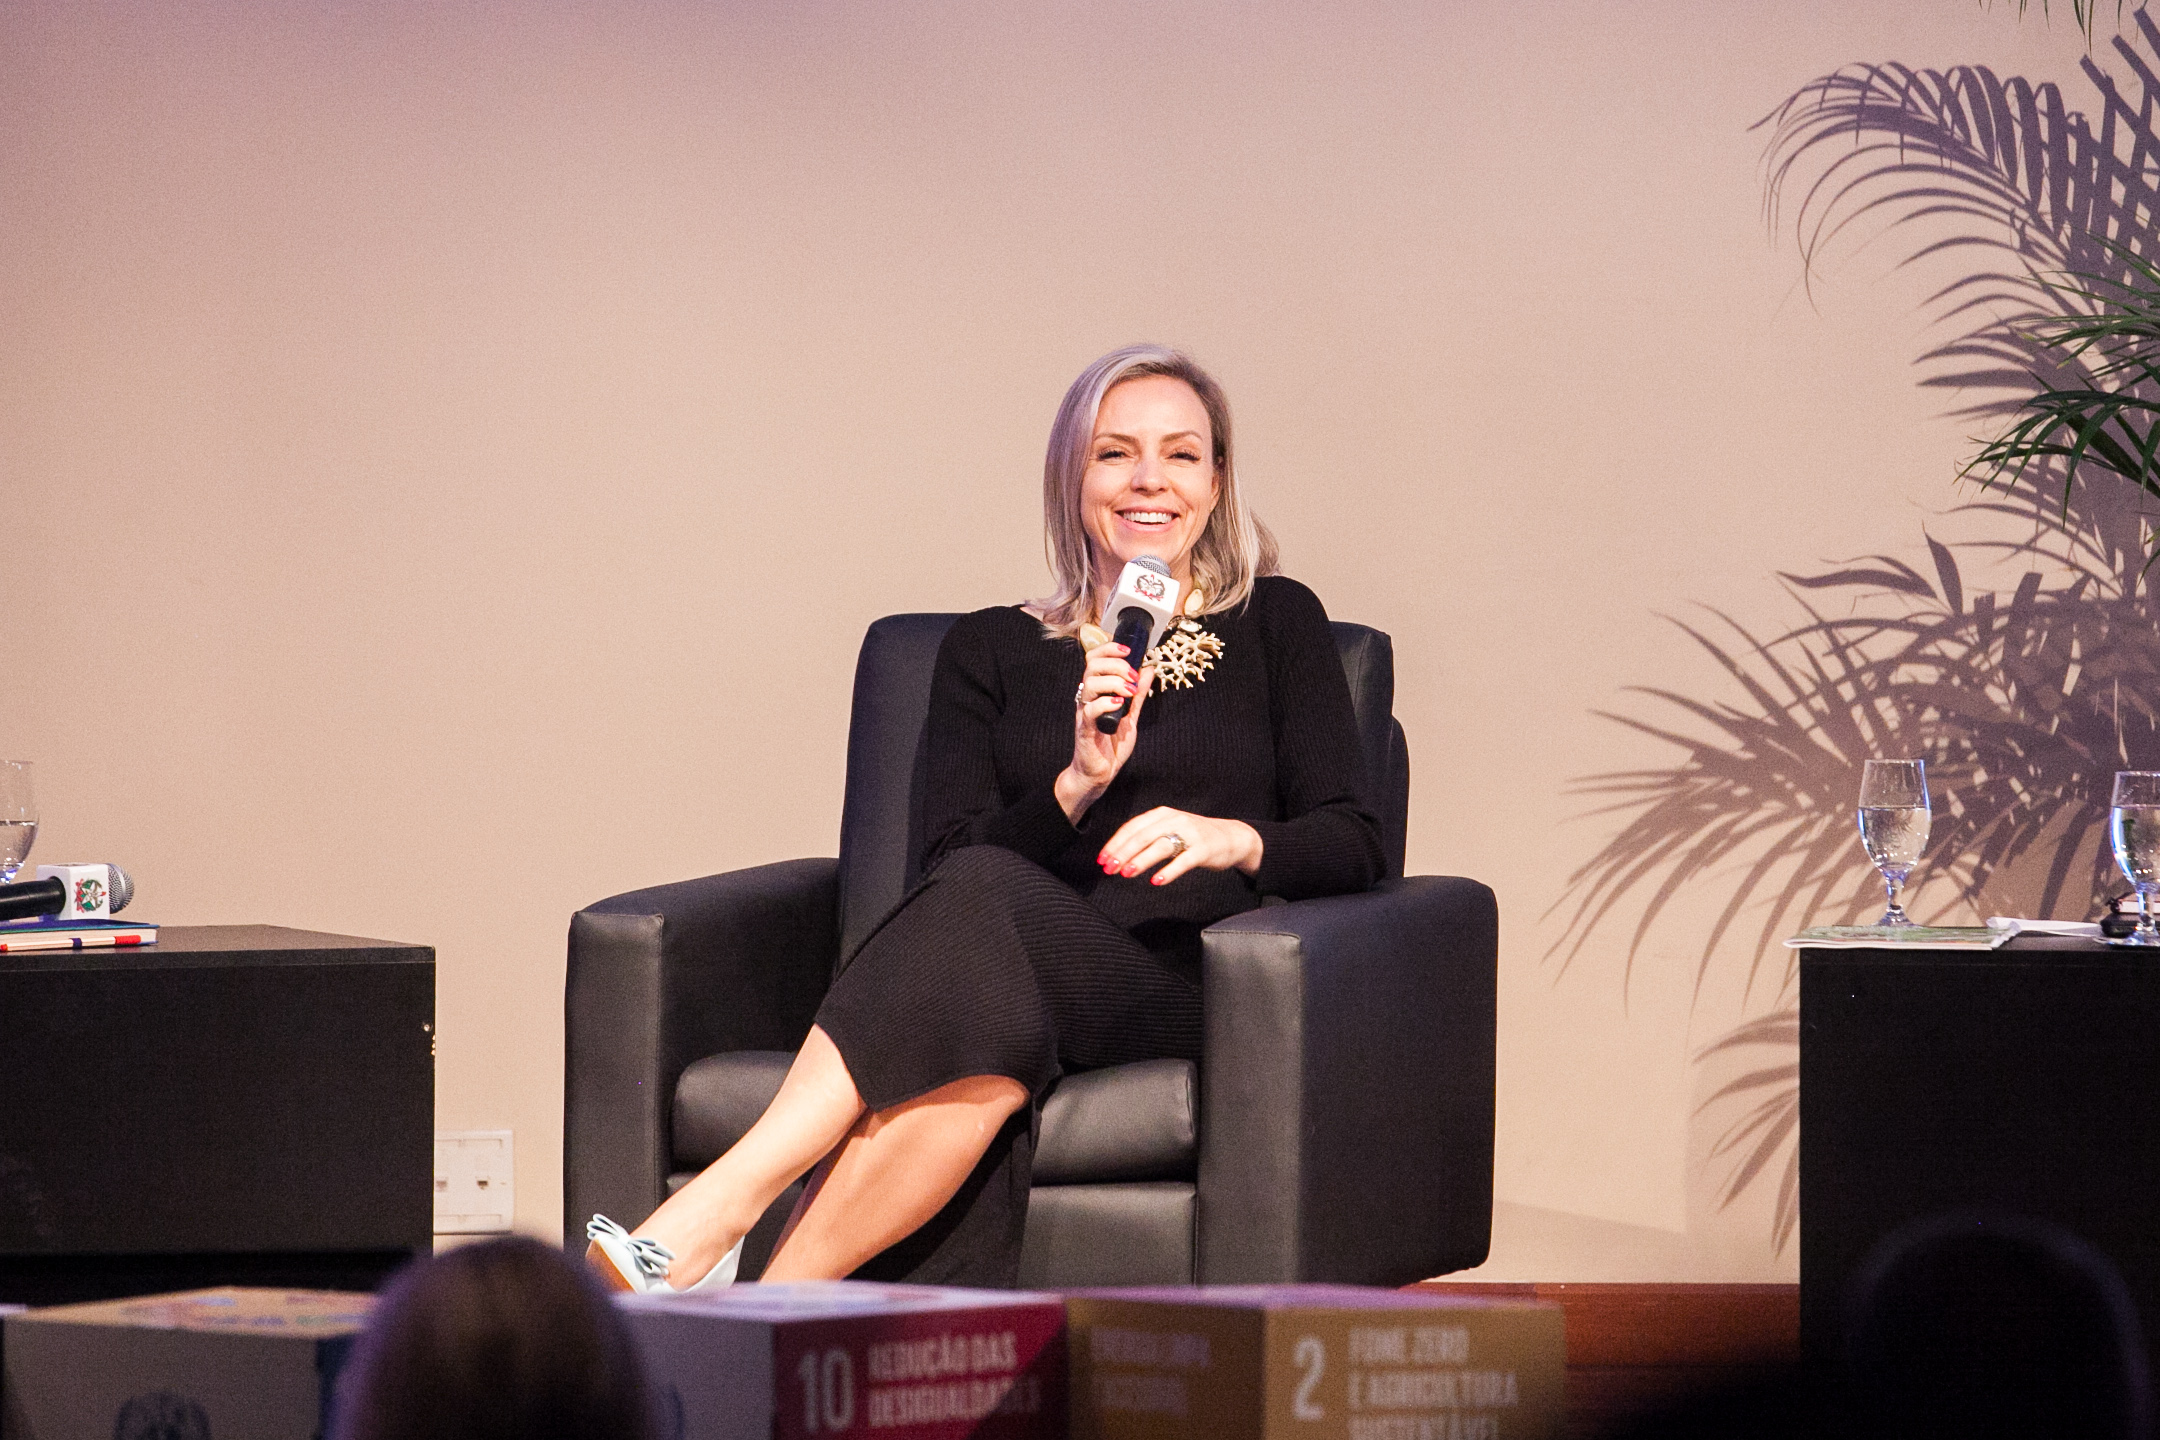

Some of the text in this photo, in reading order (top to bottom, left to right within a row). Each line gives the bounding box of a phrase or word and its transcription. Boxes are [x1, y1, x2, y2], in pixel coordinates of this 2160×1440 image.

[797, 1349, 853, 1431] 10
[971, 1330, 1017, 1372] DAS
[1291, 1336, 1326, 1420] 2
